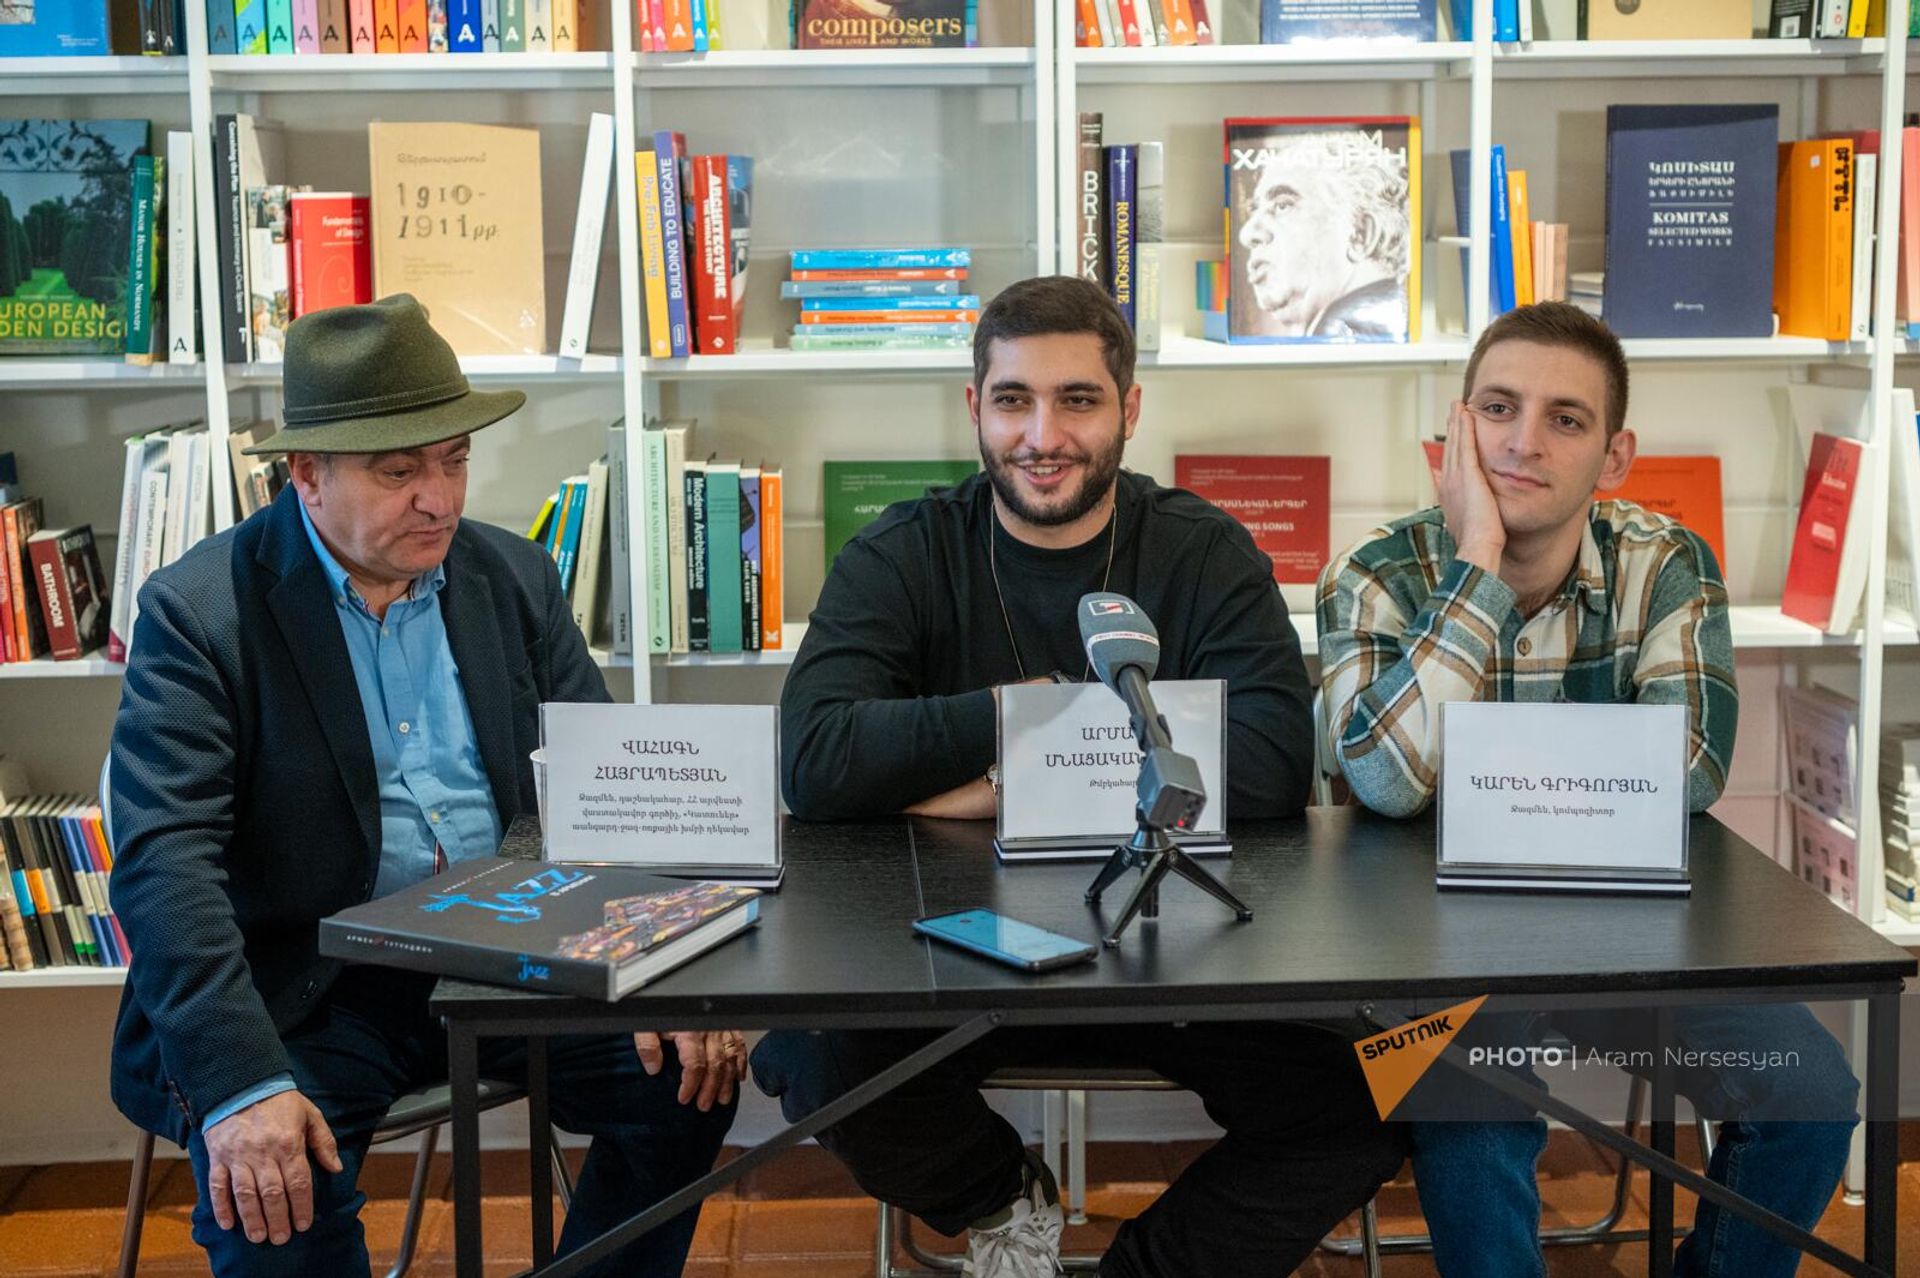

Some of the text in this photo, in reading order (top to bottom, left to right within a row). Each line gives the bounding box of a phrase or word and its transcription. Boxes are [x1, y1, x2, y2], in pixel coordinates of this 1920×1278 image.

[808, 17, 962, 44] composers
[880, 37, 898, 45] AND
[901, 37, 932, 45] WORKS
[1082, 171, 1098, 281] BRICK
[1653, 211, 1729, 224] KOMITAS
[661, 158, 683, 299] BUILDING TO EDUCATE
[710, 174, 727, 299] ARCHITECTURE
[1648, 227, 1733, 236] SELECTED WORKS
[1648, 238, 1732, 247] FACSIMILE
[1116, 201, 1130, 304] ROMANESQUE
[0, 303, 106, 320] UROPEAN
[0, 321, 43, 338] DEN
[650, 444, 659, 511] ARCHITECTURE
[146, 480, 157, 549] CONTEMPORARY
[651, 515, 660, 534] AND
[1262, 522, 1295, 532] SONGS
[693, 478, 705, 590] Modern Architecture
[40, 562, 65, 628] BATHROOM
[1082, 726, 1135, 741] ԱՐՄԱ
[622, 740, 700, 755] ՎԱՀԱԳՆ
[1045, 752, 1143, 768] ՄՆԱՑԱԿԱՆ
[594, 766, 727, 783] ՀԱՅՐԱՊԵՏՅԱՆ
[1470, 775, 1658, 794] ԿԱՐԵՆ ԳՐԻԳՈՐՅԱՆ
[1552, 805, 1616, 817] կոմպոզիտոր
